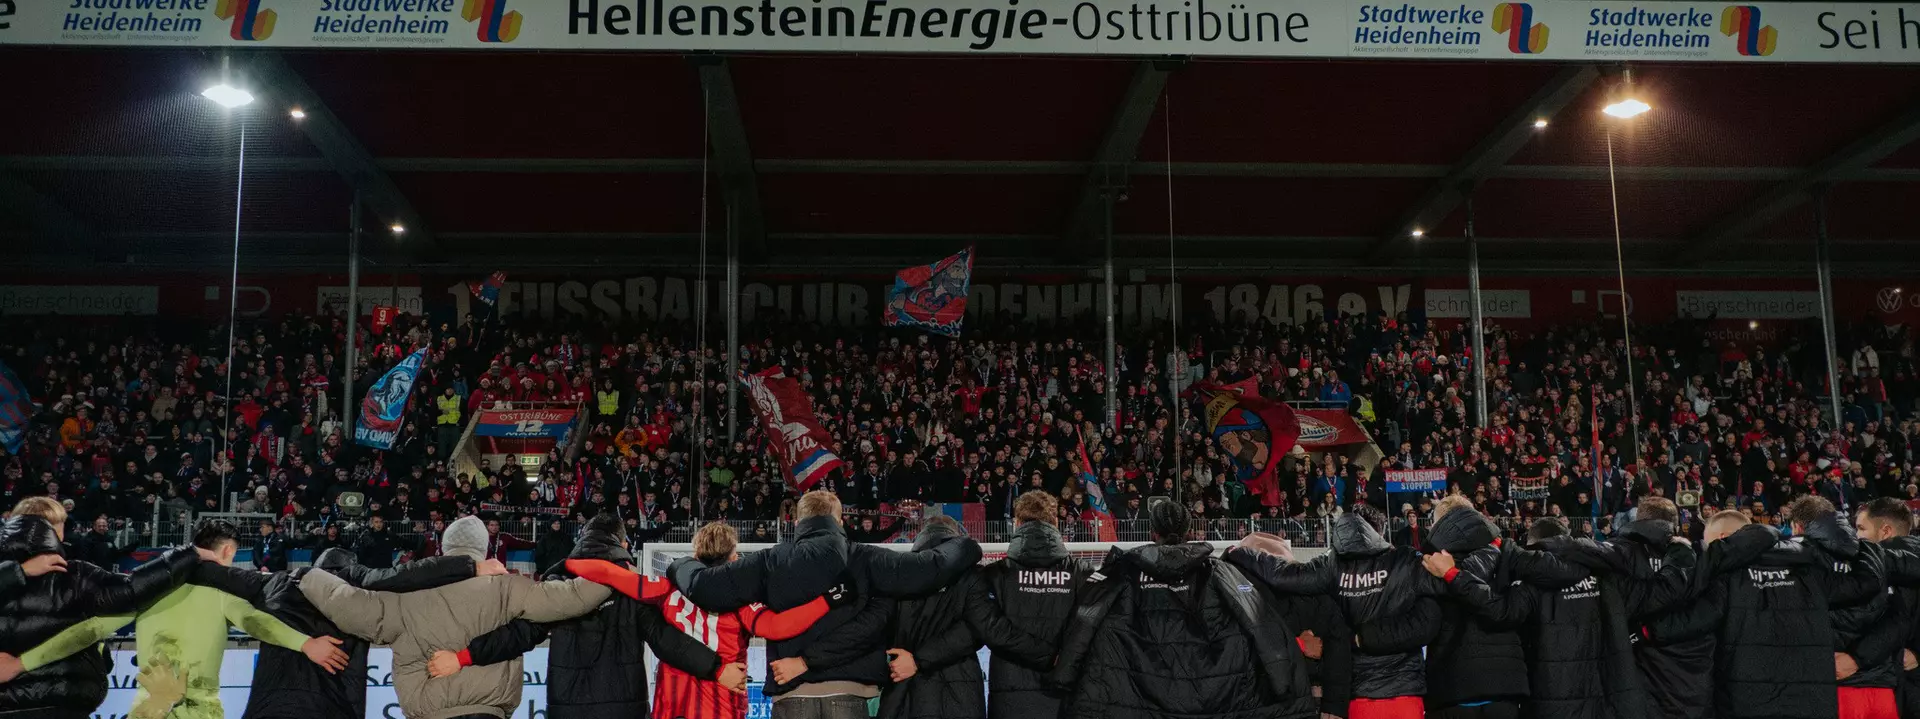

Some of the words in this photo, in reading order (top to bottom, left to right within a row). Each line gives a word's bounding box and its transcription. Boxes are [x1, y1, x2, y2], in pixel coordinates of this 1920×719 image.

[62, 13, 202, 32] Heidenheim
[1358, 4, 1484, 24] Stadtwerke
[1589, 7, 1713, 27] Stadtwerke
[313, 15, 449, 34] Heidenheim
[1817, 9, 1880, 50] Sei
[1354, 25, 1481, 45] Heidenheim
[1585, 29, 1710, 48] Heidenheim
[1204, 283, 1324, 326] 1846
[1427, 296, 1519, 313] schnider
[1687, 295, 1812, 315] Bierschneider
[499, 411, 563, 420] OSTTRIBÜNE
[515, 420, 544, 432] 12
[1385, 469, 1446, 482] POPULISMUS
[1401, 482, 1433, 490] STOPPEN
[1034, 571, 1071, 585] MHP
[1356, 570, 1388, 589] MHP
[669, 590, 719, 652] 30
